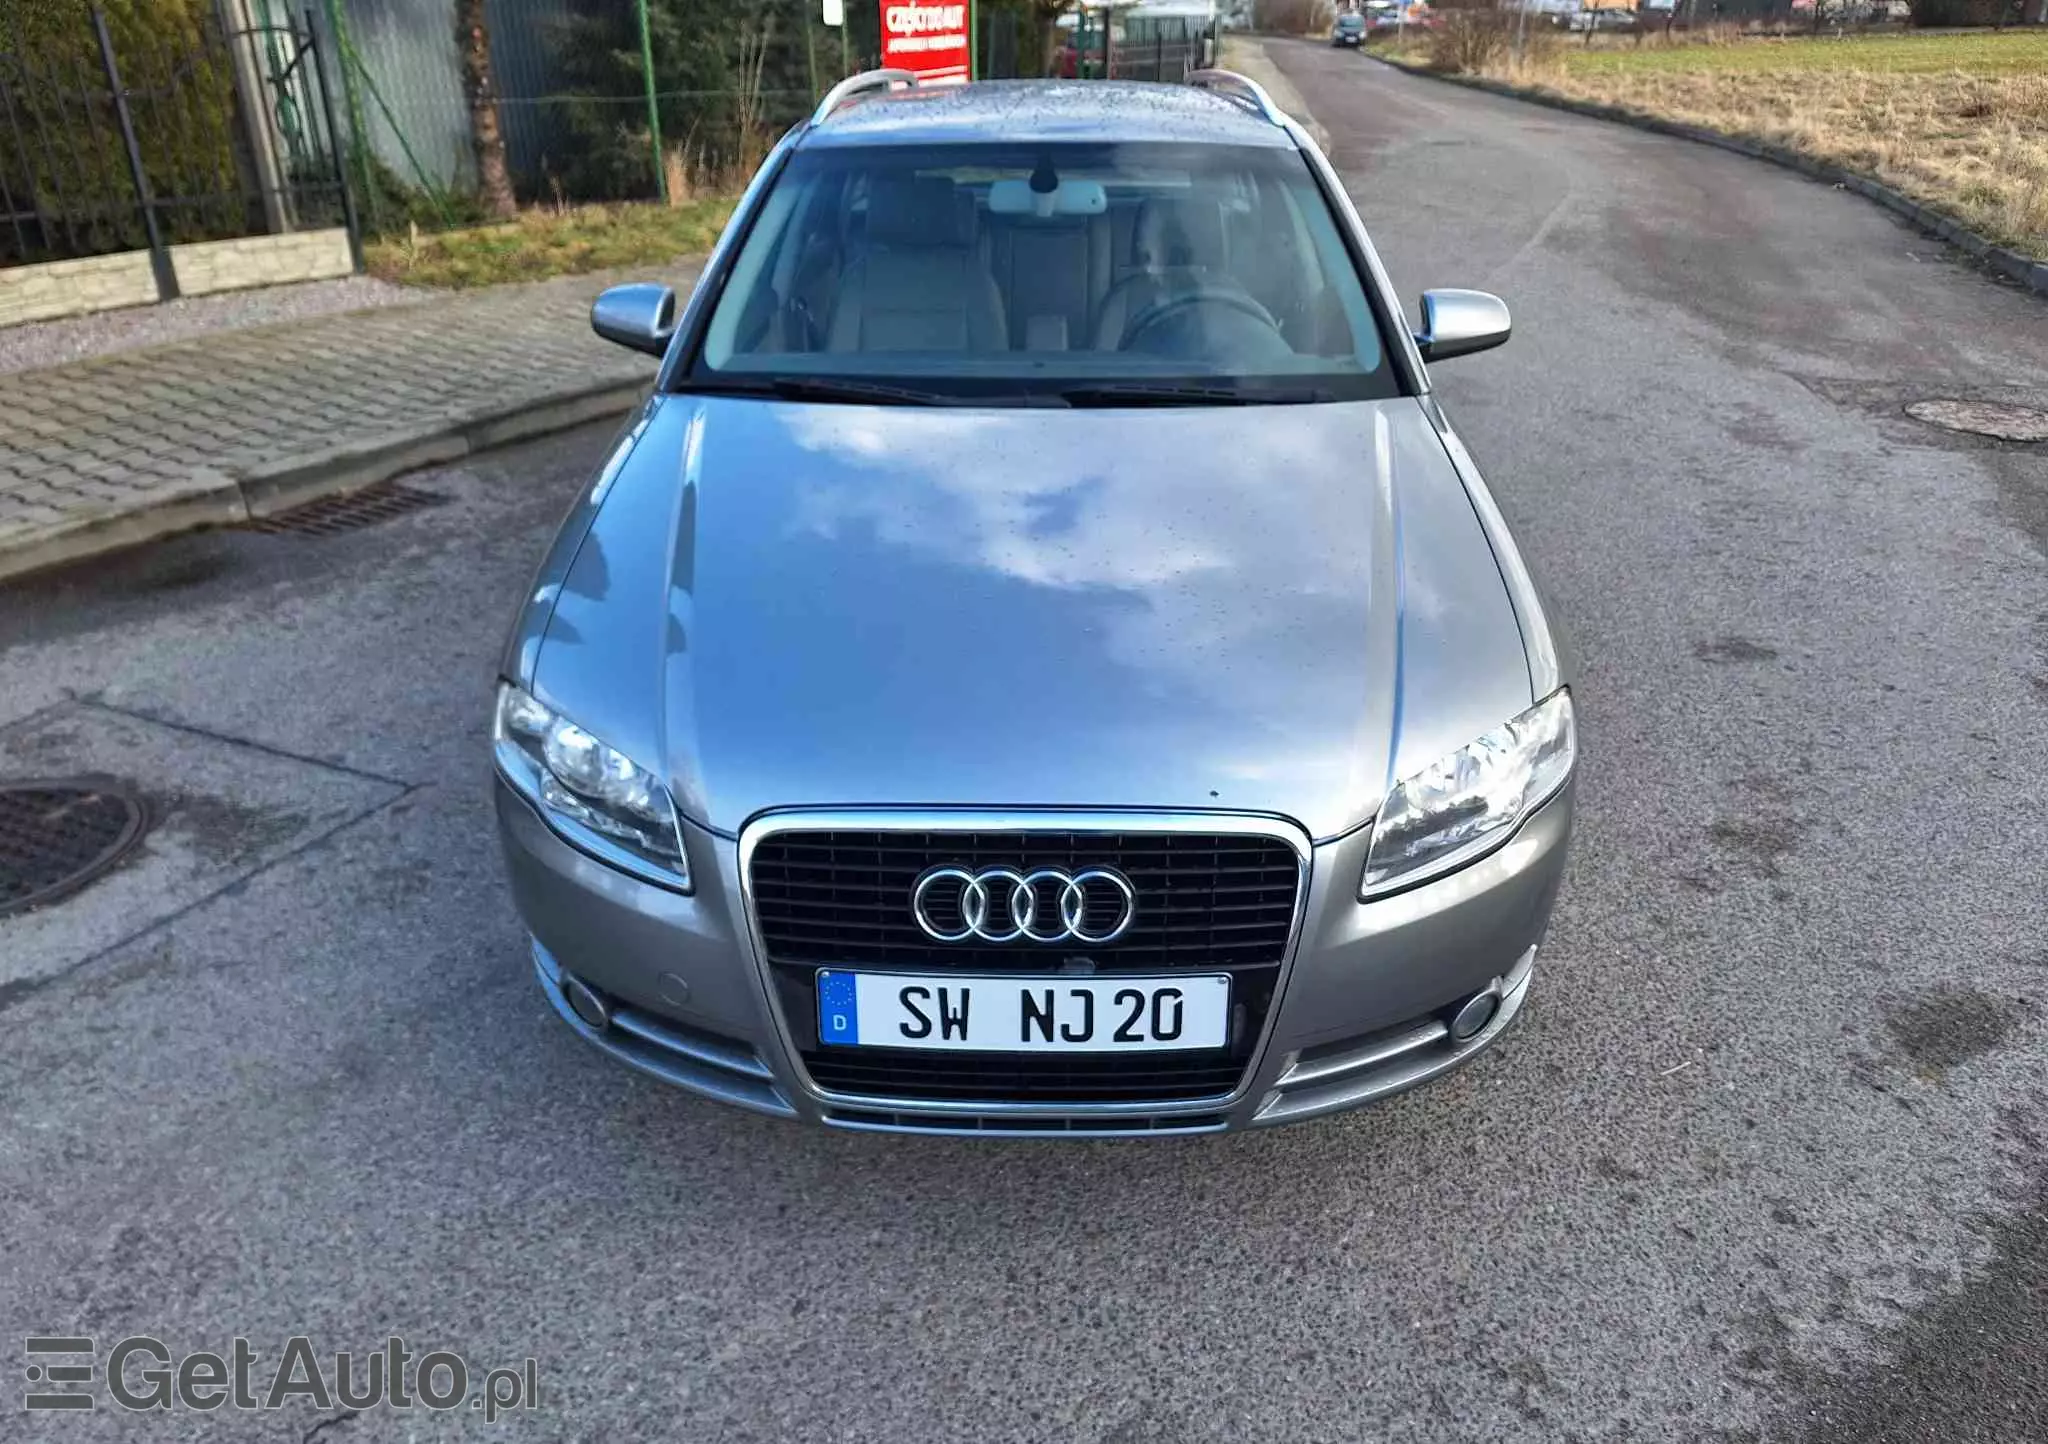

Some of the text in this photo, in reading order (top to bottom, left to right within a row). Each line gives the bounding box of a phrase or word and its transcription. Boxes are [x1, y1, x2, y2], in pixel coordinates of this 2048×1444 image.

[833, 1015, 848, 1031] D
[899, 986, 1183, 1043] SW NJ 20
